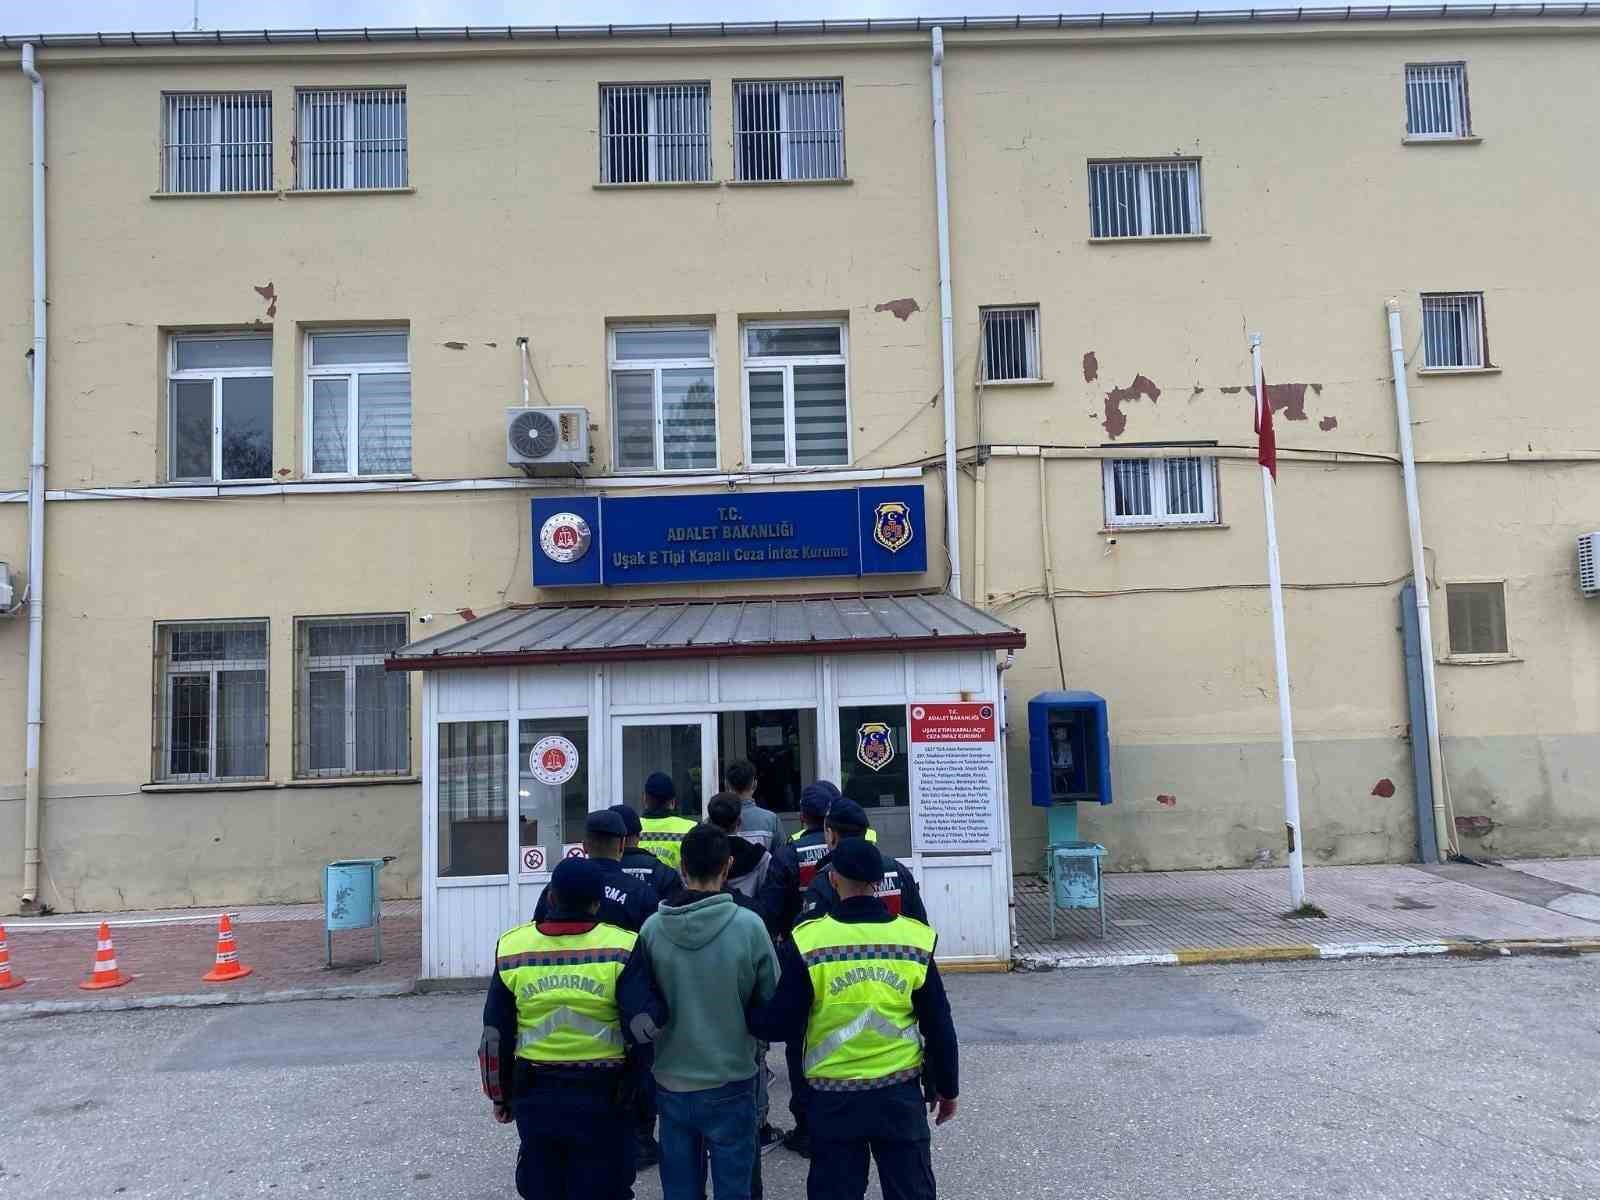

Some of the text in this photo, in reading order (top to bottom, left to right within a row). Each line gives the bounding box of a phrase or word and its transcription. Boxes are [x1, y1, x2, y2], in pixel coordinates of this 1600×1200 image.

[717, 506, 743, 521] T.C.
[666, 526, 718, 542] ADALET
[612, 551, 646, 569] Uşak
[649, 551, 658, 565] E
[661, 548, 686, 567] Tipi
[734, 545, 765, 561] Ceza
[767, 543, 800, 560] İnfaz
[802, 543, 850, 559] Kurumu
[522, 974, 607, 999] JANDARMA
[831, 967, 908, 995] JANDARMA
